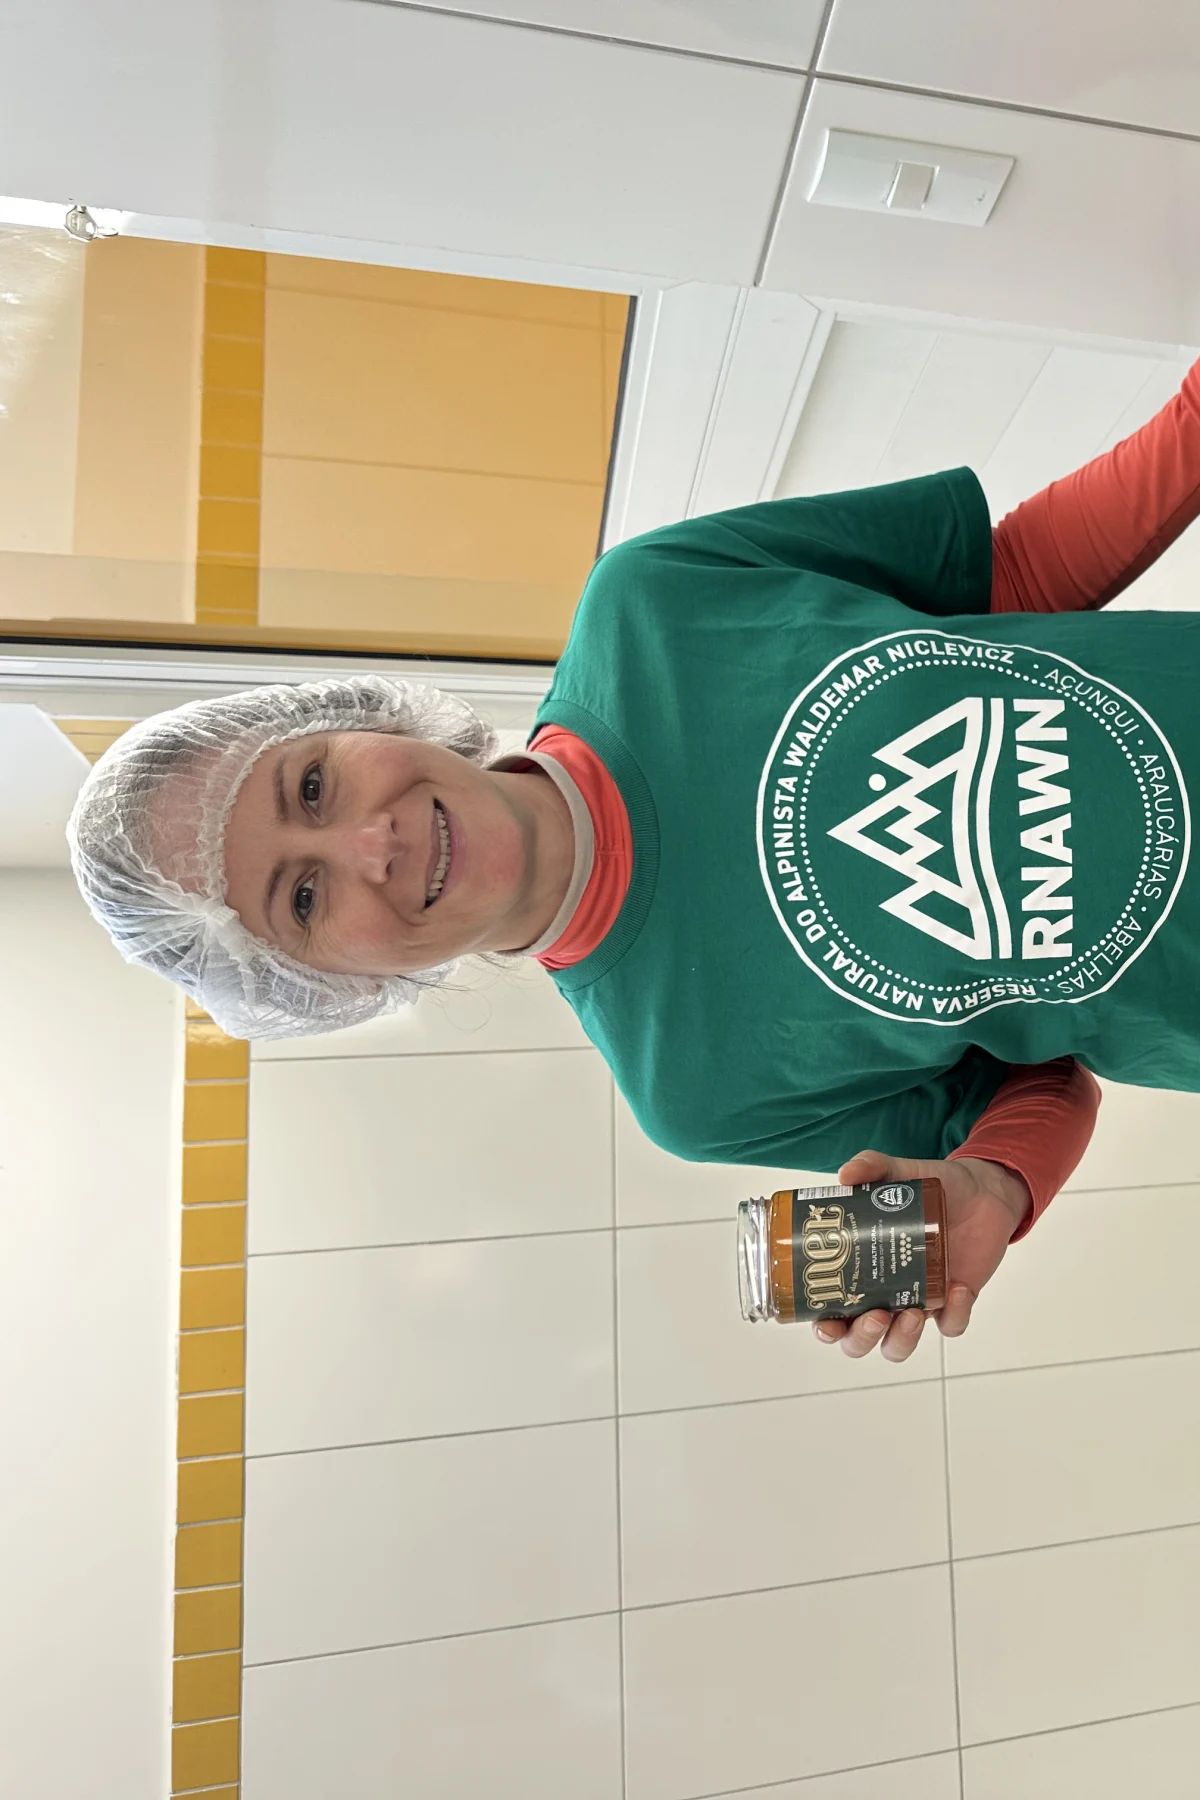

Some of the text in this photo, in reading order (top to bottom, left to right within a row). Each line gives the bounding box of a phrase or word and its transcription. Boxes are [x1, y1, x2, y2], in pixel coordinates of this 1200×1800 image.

[773, 640, 1037, 1014] RESERVA NATURAL DO ALPINISTA WALDEMAR NICLEVICZ
[1013, 698, 1073, 960] RNAWN
[1044, 668, 1179, 993] AÇUNGUI ARAUCÁRIAS ABELHAS
